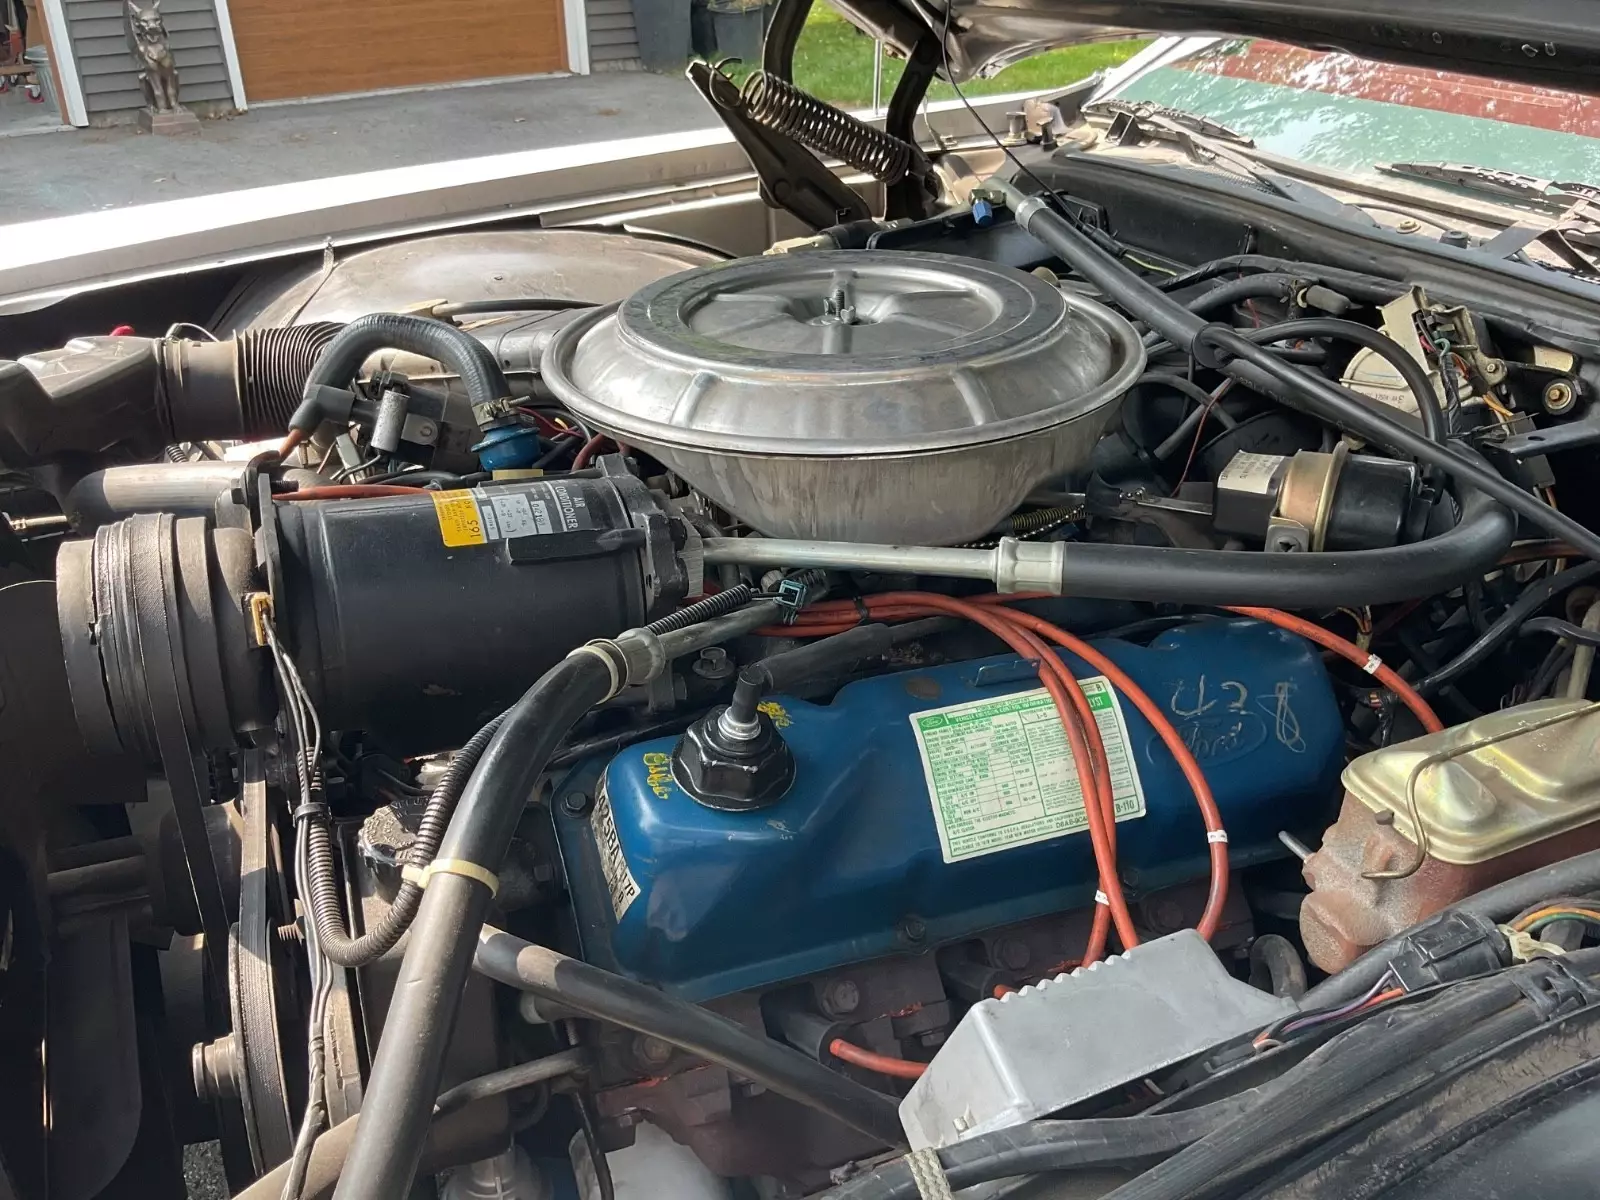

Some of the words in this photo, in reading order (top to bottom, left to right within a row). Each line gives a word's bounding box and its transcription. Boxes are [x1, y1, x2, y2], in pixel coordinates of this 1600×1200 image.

[555, 486, 579, 529] CONDITIONER
[573, 497, 585, 508] AIR
[467, 519, 481, 538] 165
[1088, 696, 1103, 707] LYST
